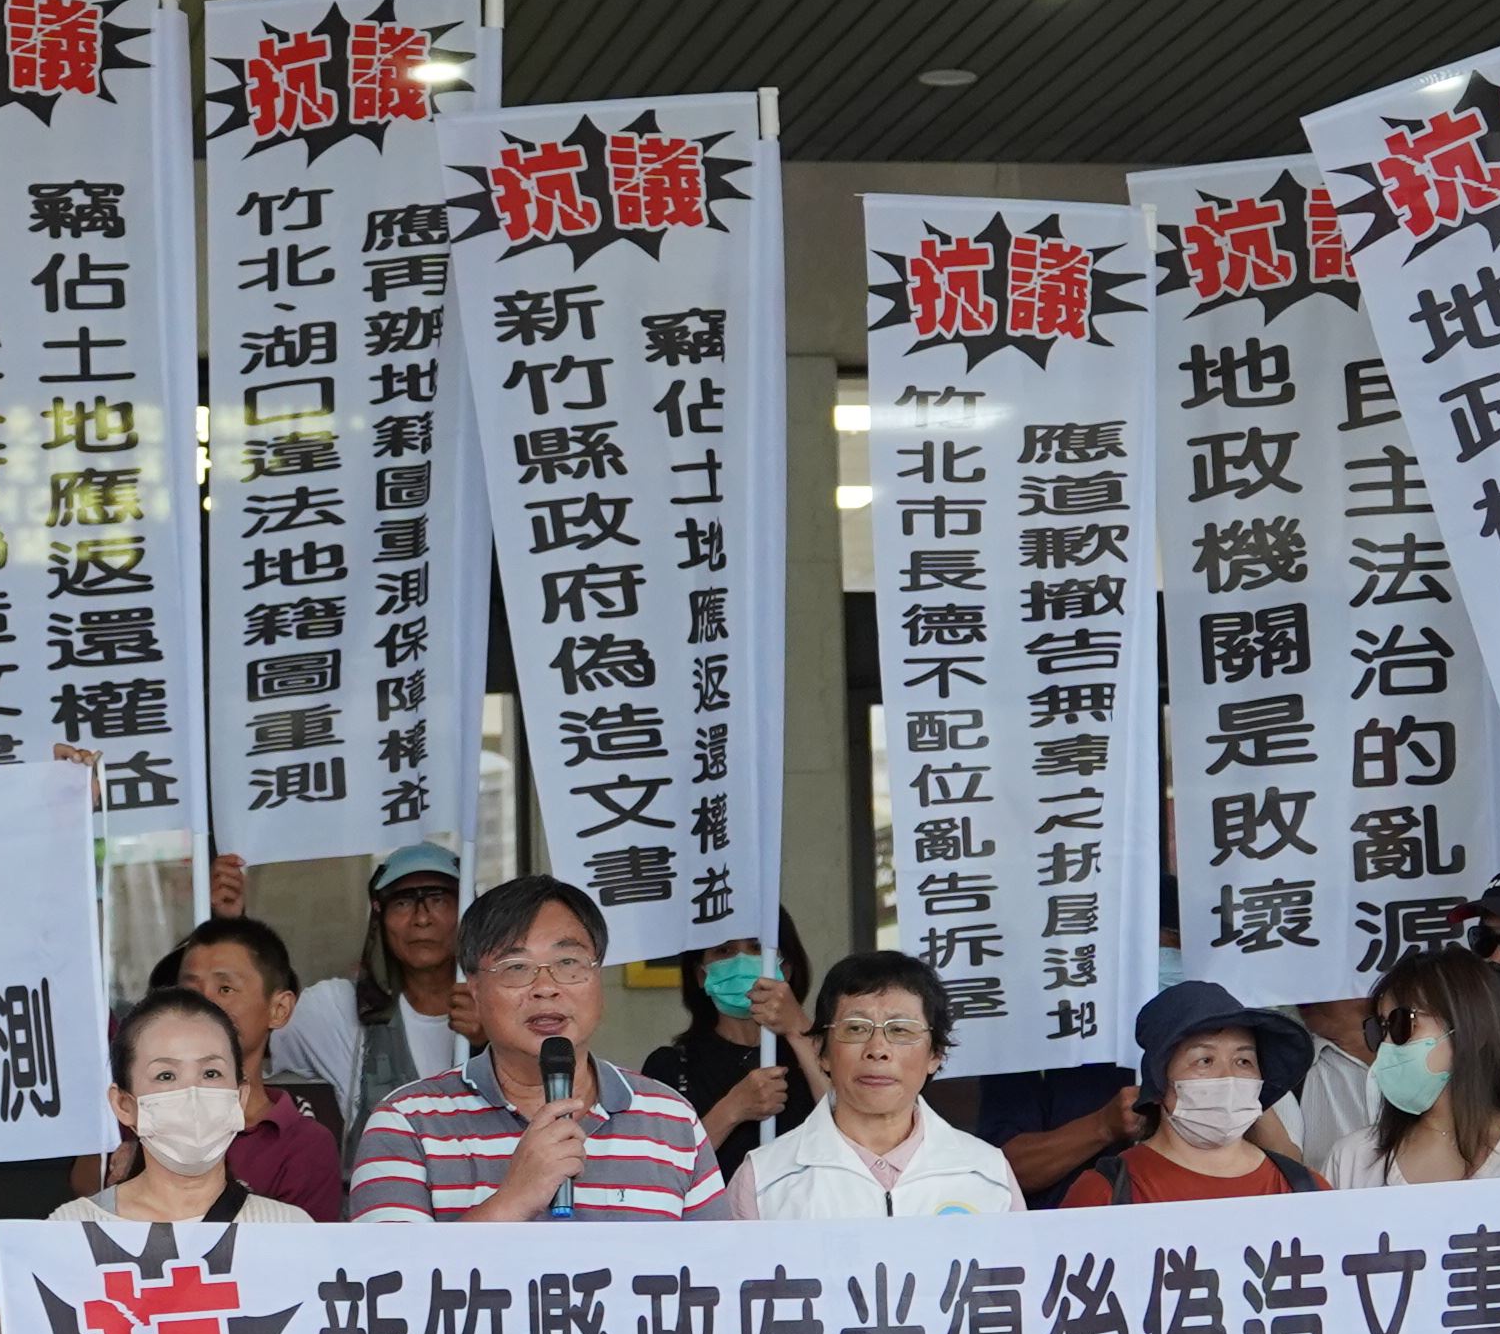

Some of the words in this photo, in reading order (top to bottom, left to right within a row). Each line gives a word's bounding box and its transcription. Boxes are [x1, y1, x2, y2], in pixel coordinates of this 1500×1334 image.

[246, 19, 433, 137] 抗議
[489, 133, 706, 242] 抗議
[905, 234, 1093, 341] 抗議
[491, 284, 680, 908] 新竹縣政府偽造文書
[1178, 337, 1321, 955] 地政機關是敗壞
